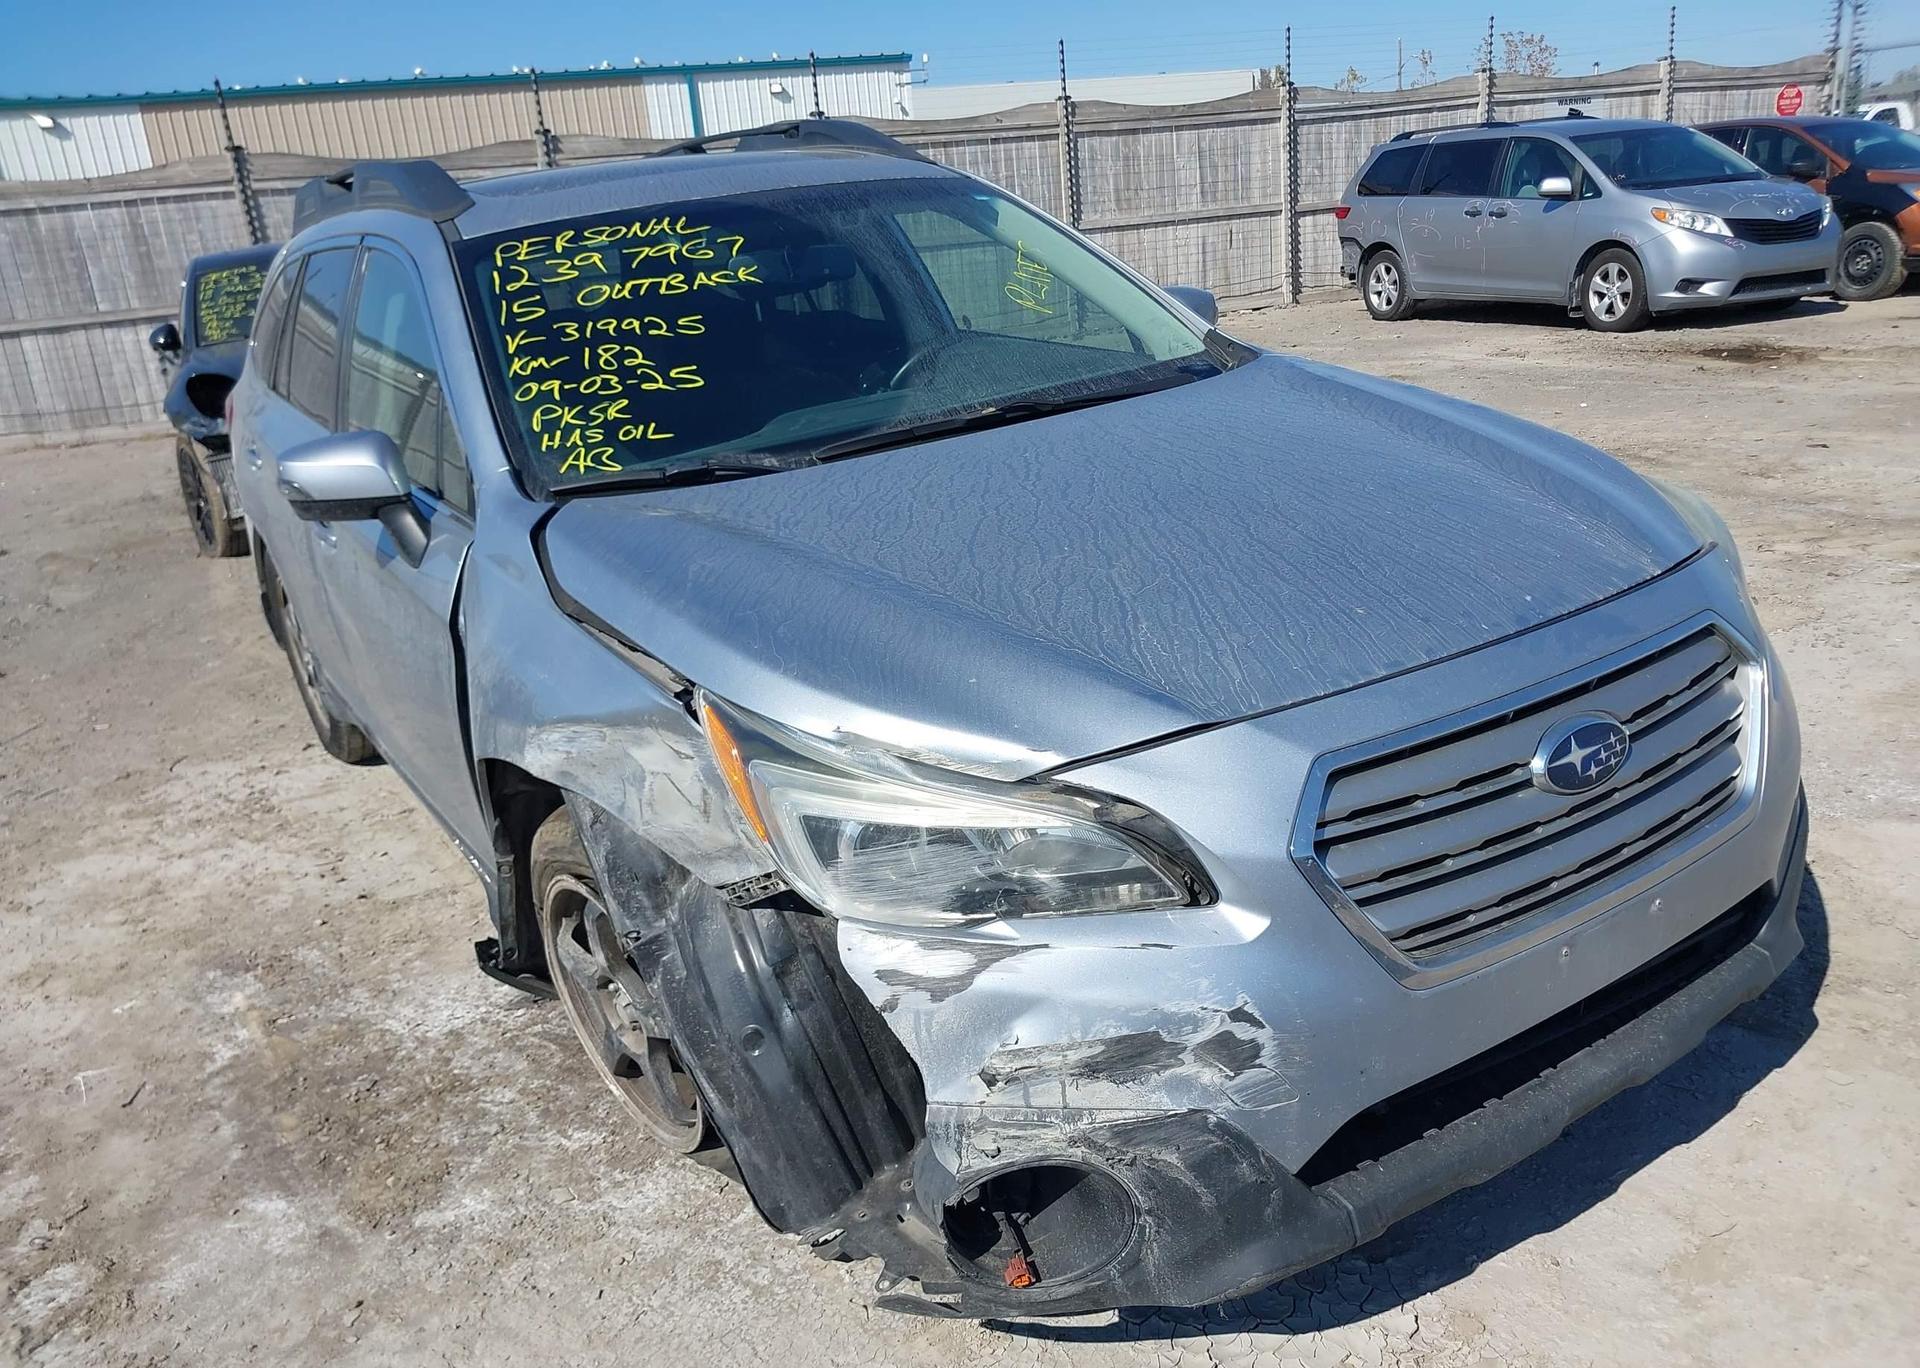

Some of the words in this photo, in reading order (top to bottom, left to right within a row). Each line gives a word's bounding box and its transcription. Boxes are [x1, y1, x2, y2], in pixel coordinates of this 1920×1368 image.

[1557, 96, 1592, 106] WARNING
[495, 216, 711, 267] PERSONAL
[500, 295, 546, 326] 15
[576, 265, 763, 306] OUTBACK
[553, 316, 705, 341] 319925
[584, 345, 656, 369] 182
[515, 366, 705, 402] 09-03-25
[541, 429, 604, 452] HAS
[618, 423, 675, 442] OIL
